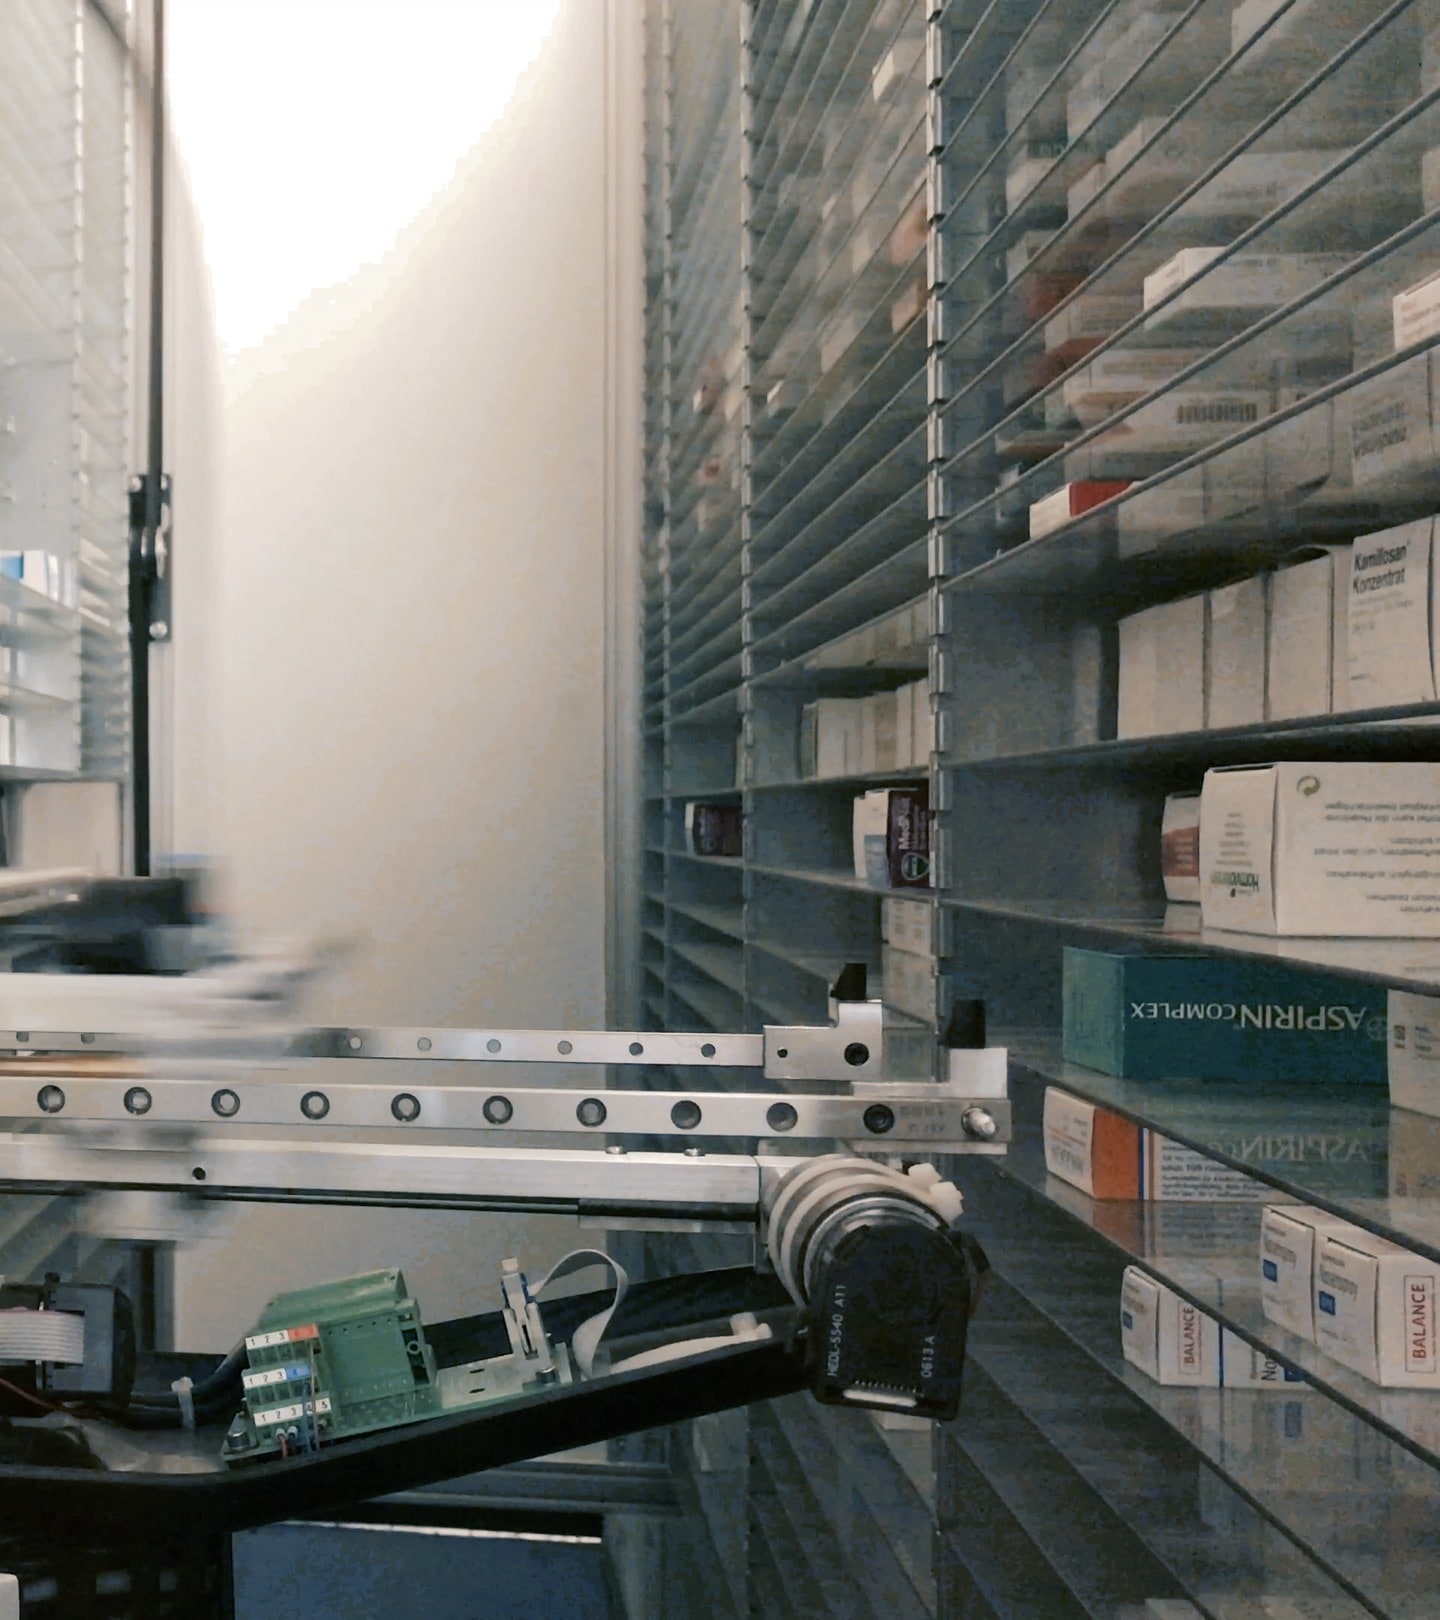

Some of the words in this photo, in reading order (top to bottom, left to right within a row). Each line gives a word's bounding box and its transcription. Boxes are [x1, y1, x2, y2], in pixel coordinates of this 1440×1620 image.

[1354, 544, 1408, 572] Kamillosan
[1353, 568, 1405, 595] Konzentrat
[1131, 1001, 1235, 1020] COMPLEX
[1241, 1003, 1367, 1031] ASPIRIN
[1411, 1283, 1427, 1359] BALANCE
[1183, 1306, 1195, 1365] BALANCE
